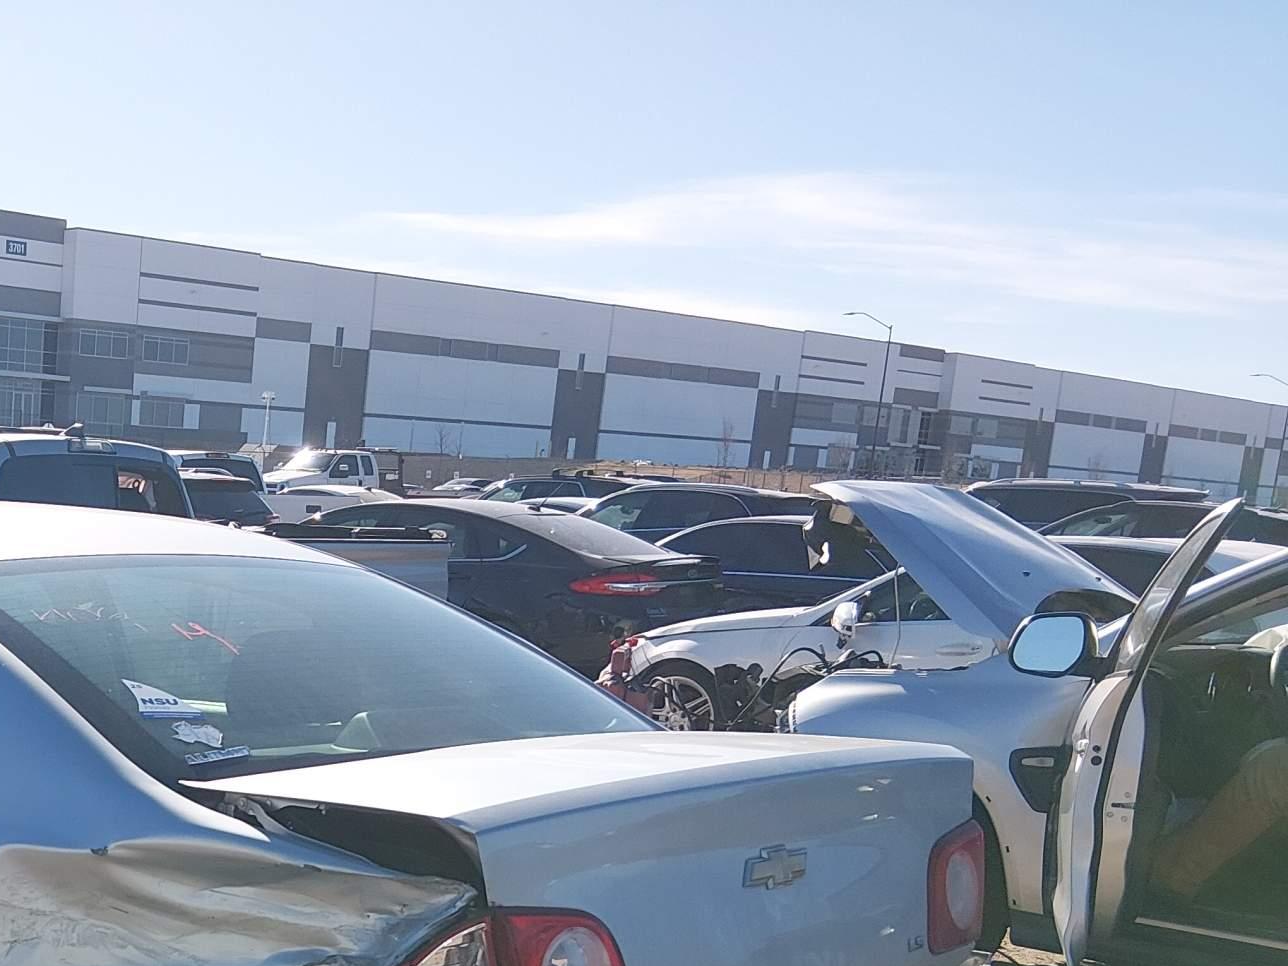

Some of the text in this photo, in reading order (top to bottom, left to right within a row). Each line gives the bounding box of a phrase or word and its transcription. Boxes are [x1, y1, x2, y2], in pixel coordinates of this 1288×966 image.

[8, 242, 25, 255] 3701
[140, 698, 179, 706] NSU
[906, 936, 924, 952] LS
